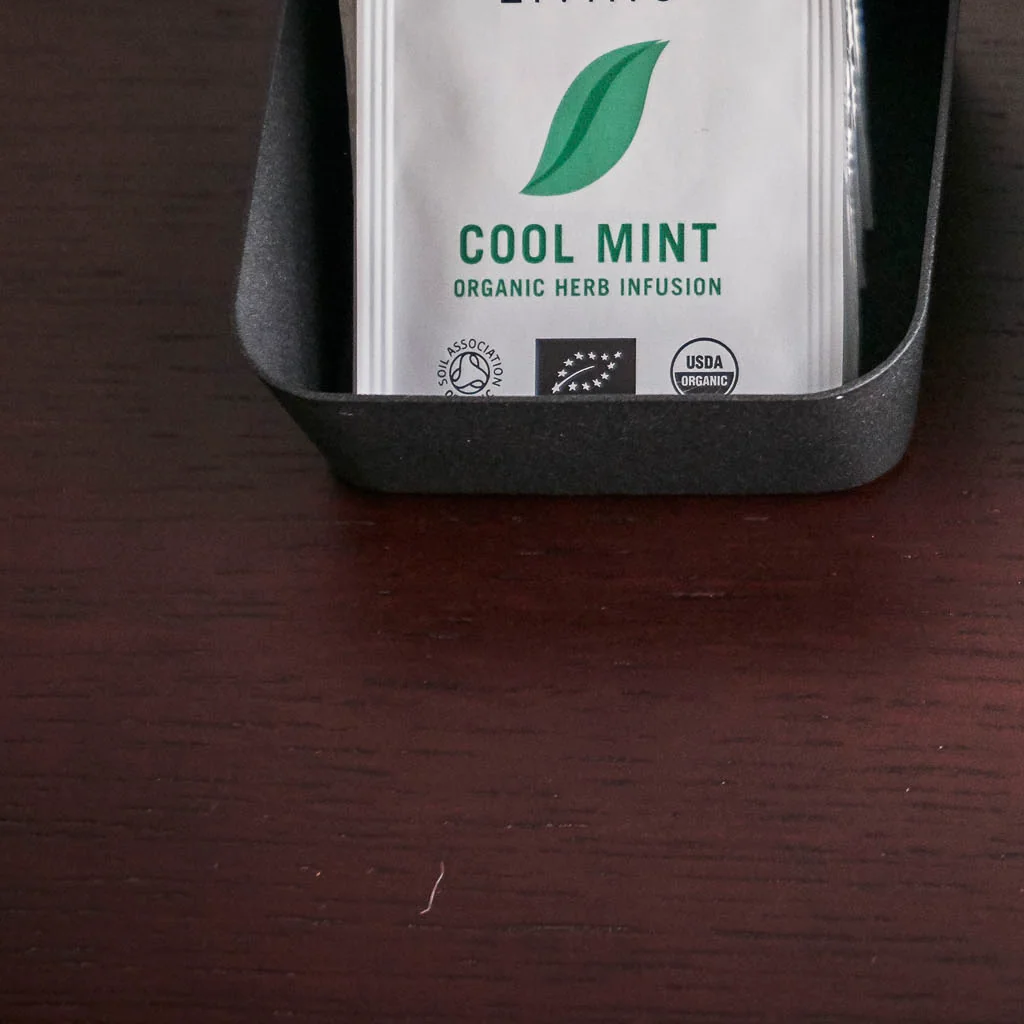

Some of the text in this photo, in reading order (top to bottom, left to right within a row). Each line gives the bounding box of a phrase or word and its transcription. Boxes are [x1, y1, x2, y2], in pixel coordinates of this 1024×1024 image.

[459, 223, 717, 265] COOL MINT
[453, 277, 722, 298] ORGANIC HERB INFUSION
[437, 338, 503, 387] SOIL ASSOCIATION
[686, 354, 723, 369] USDA
[681, 375, 728, 387] ORGANIC
